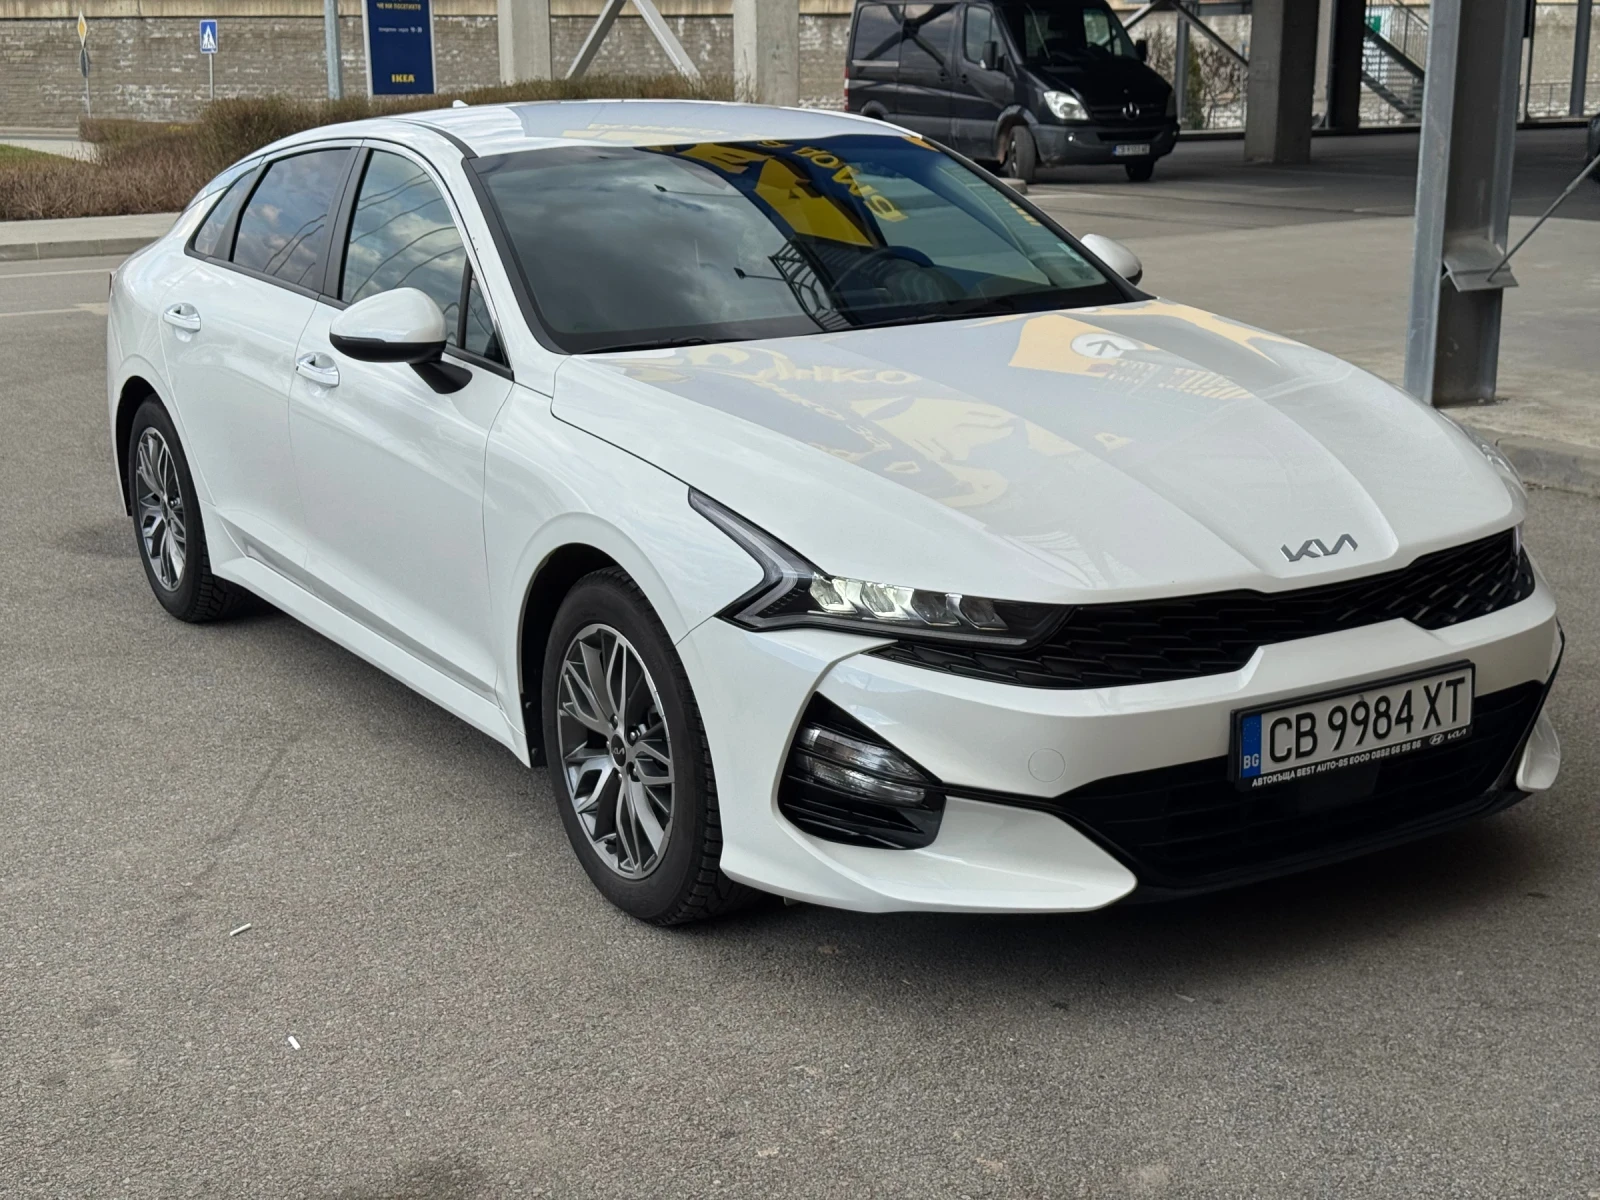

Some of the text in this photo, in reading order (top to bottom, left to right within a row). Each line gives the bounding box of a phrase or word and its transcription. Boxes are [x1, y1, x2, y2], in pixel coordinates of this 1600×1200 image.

[391, 74, 415, 83] IKEA
[1280, 533, 1358, 562] KIA
[1269, 676, 1466, 763] CB 9984 XT
[1243, 753, 1260, 770] BG
